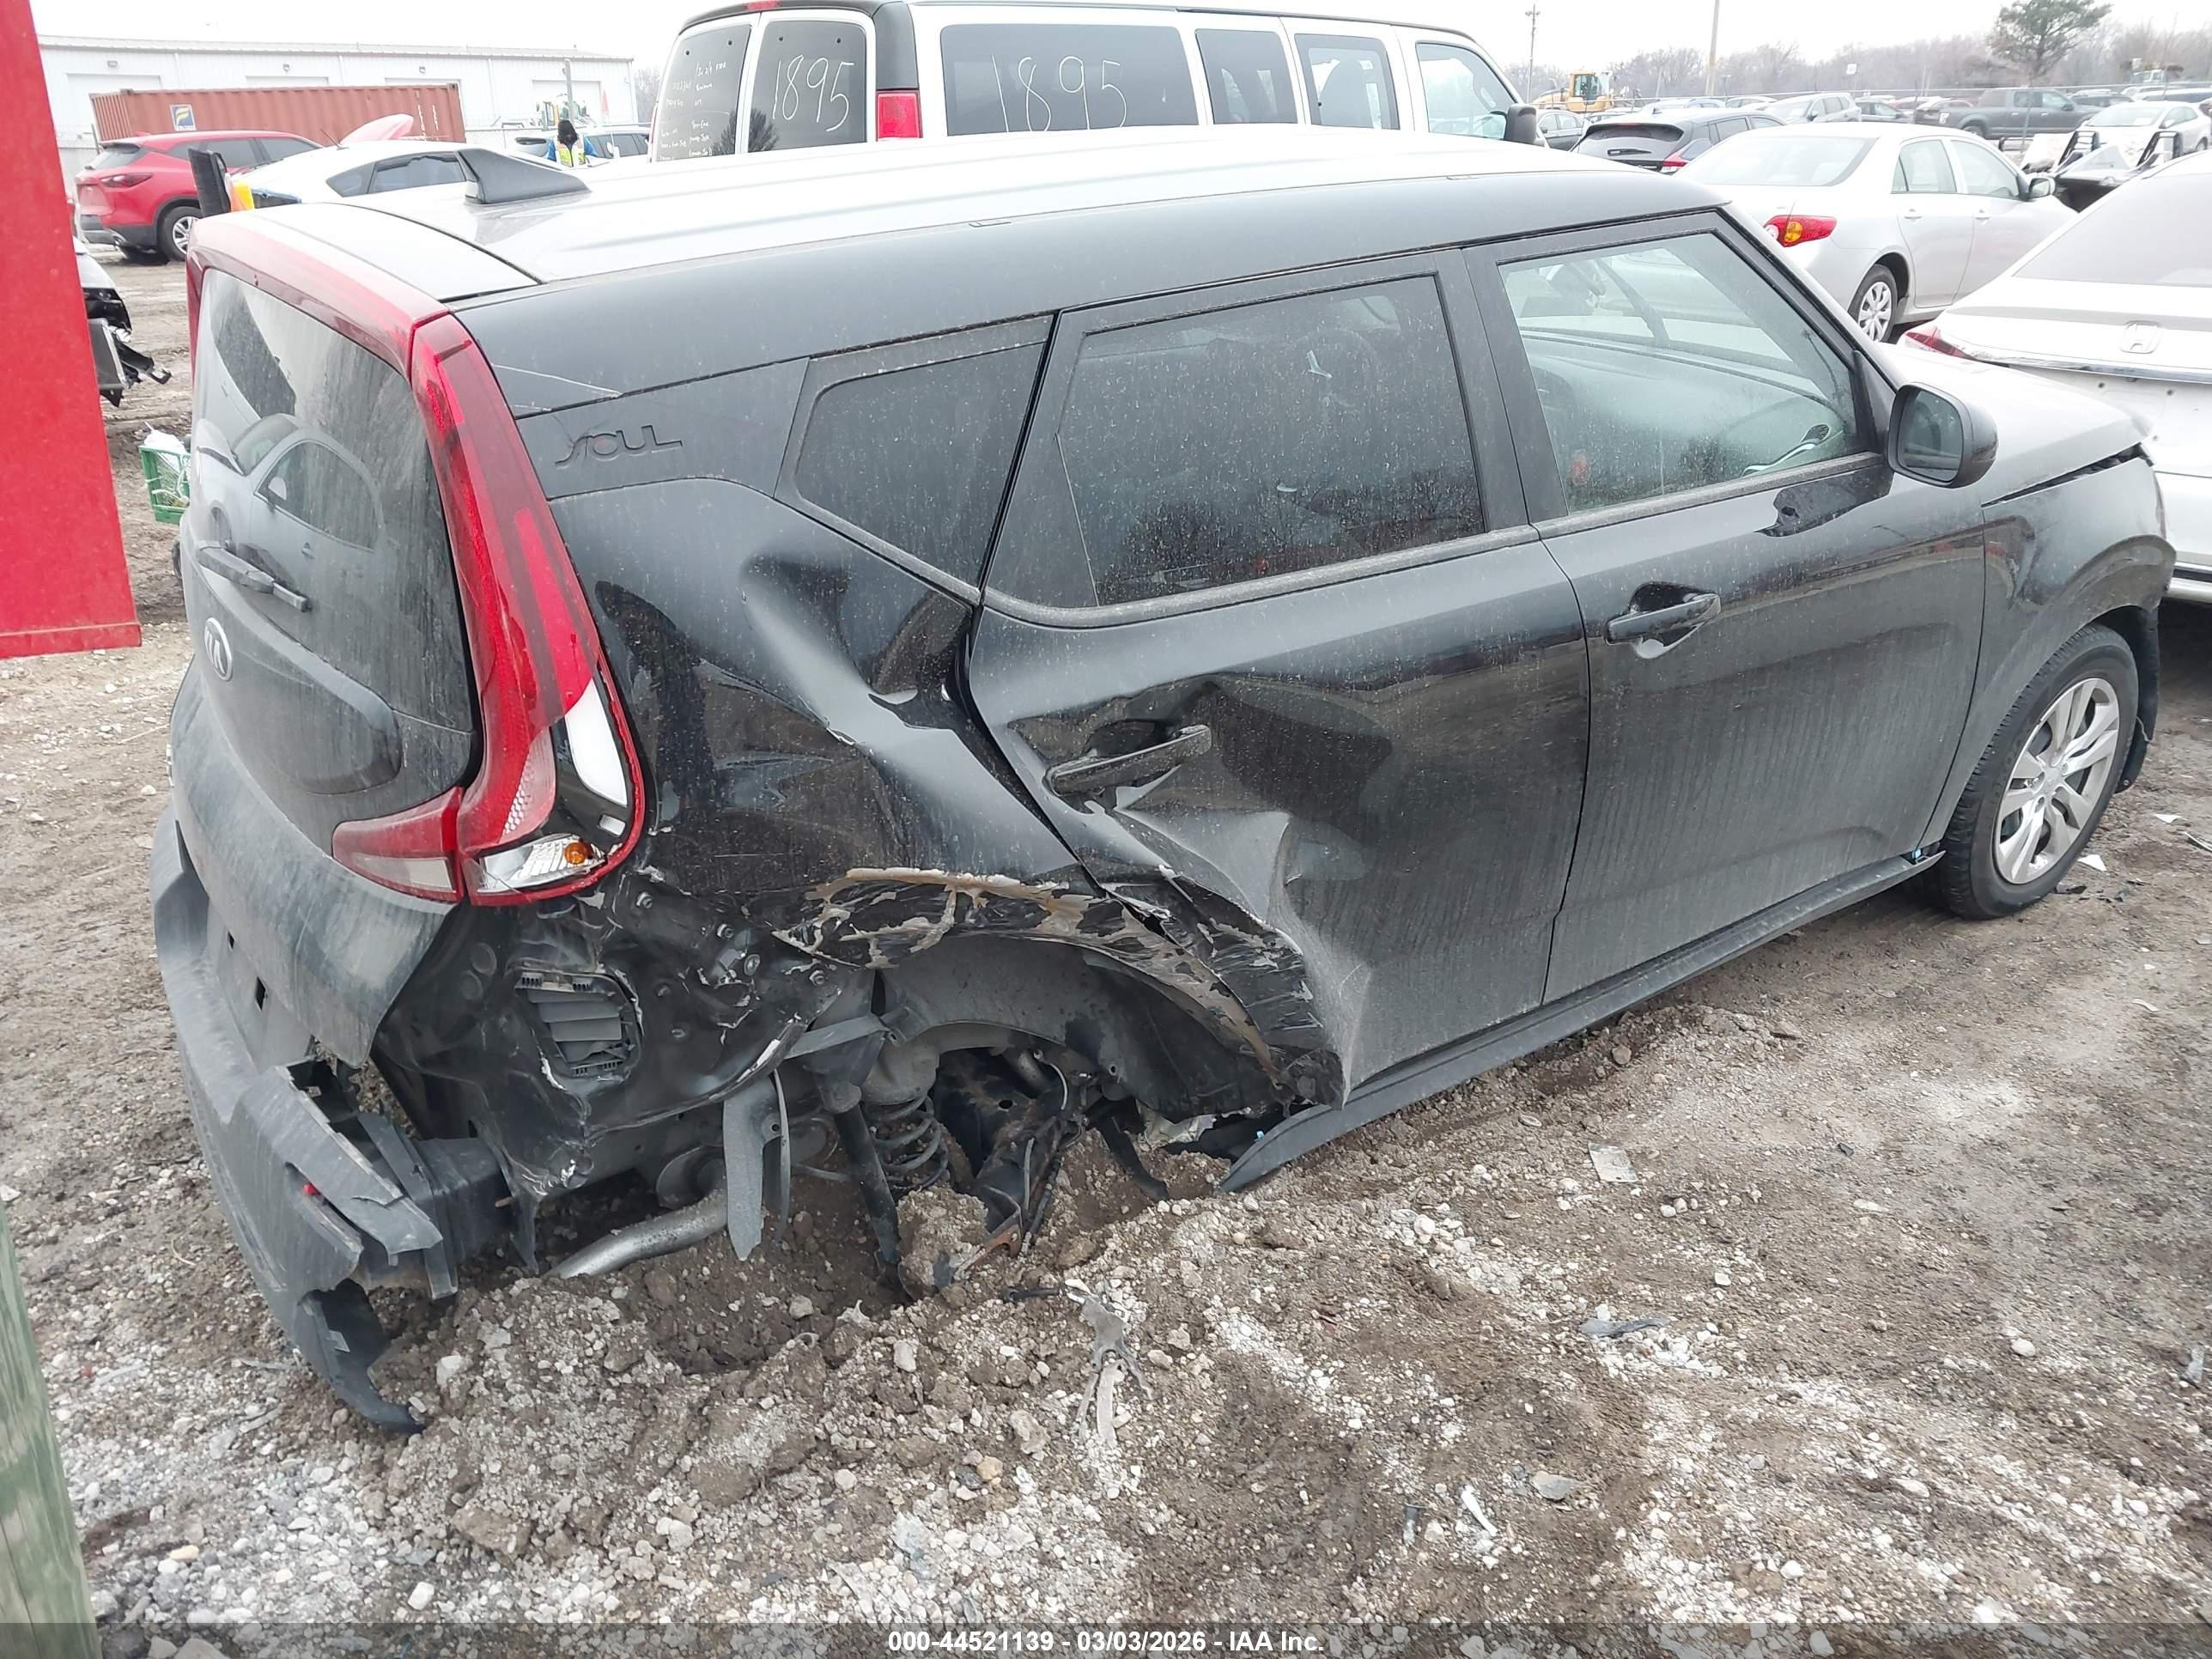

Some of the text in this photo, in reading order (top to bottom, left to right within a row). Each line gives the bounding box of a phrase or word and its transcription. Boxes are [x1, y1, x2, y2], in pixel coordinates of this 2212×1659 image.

[772, 54, 854, 131] 1895
[992, 55, 1127, 132] 1895
[555, 424, 684, 470] SOUL
